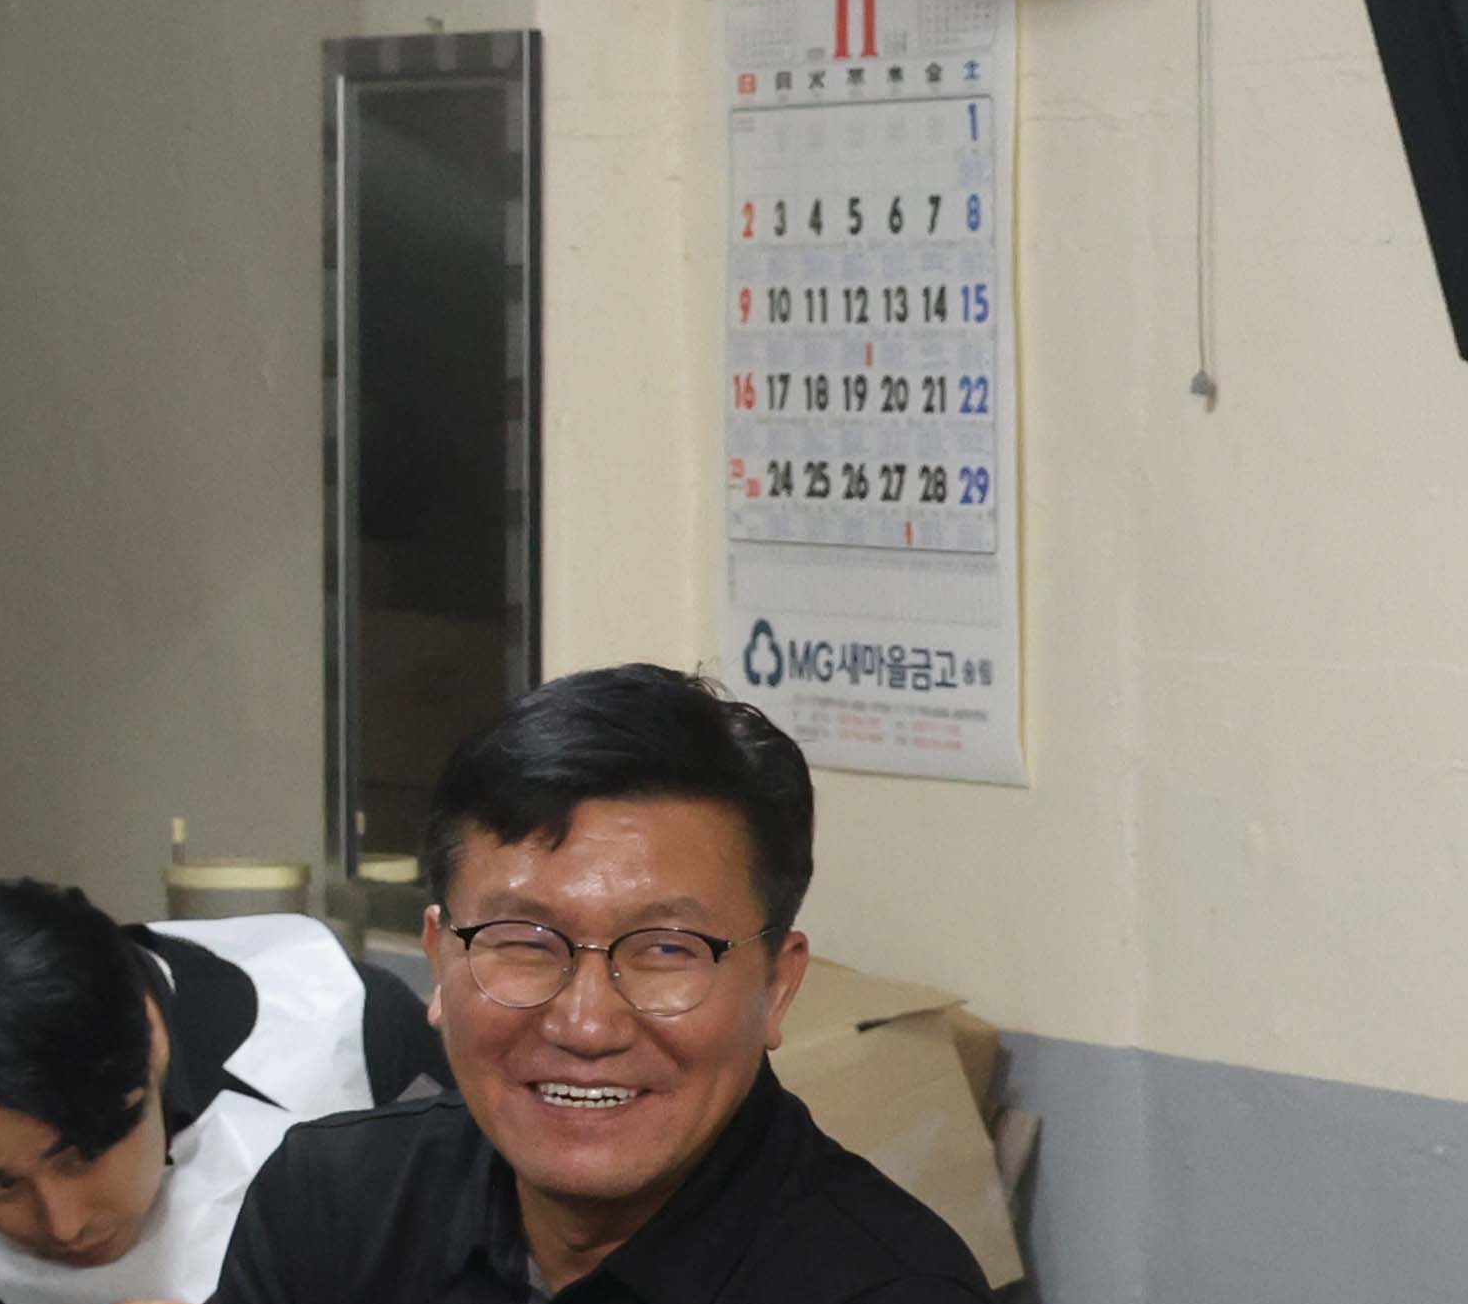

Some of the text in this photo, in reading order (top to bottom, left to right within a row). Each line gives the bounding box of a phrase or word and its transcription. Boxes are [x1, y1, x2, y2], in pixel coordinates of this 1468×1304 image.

[741, 194, 981, 238] 2 3 4 5 6 7 8
[739, 283, 989, 324] 9 10 11 12 13 14 15
[732, 372, 989, 414] 16 17 18 19 20 21 22
[767, 461, 794, 497] 24
[804, 461, 831, 498] 25
[841, 463, 869, 501] 26
[880, 464, 907, 502] 27
[919, 466, 947, 504] 28
[958, 466, 989, 505] 29
